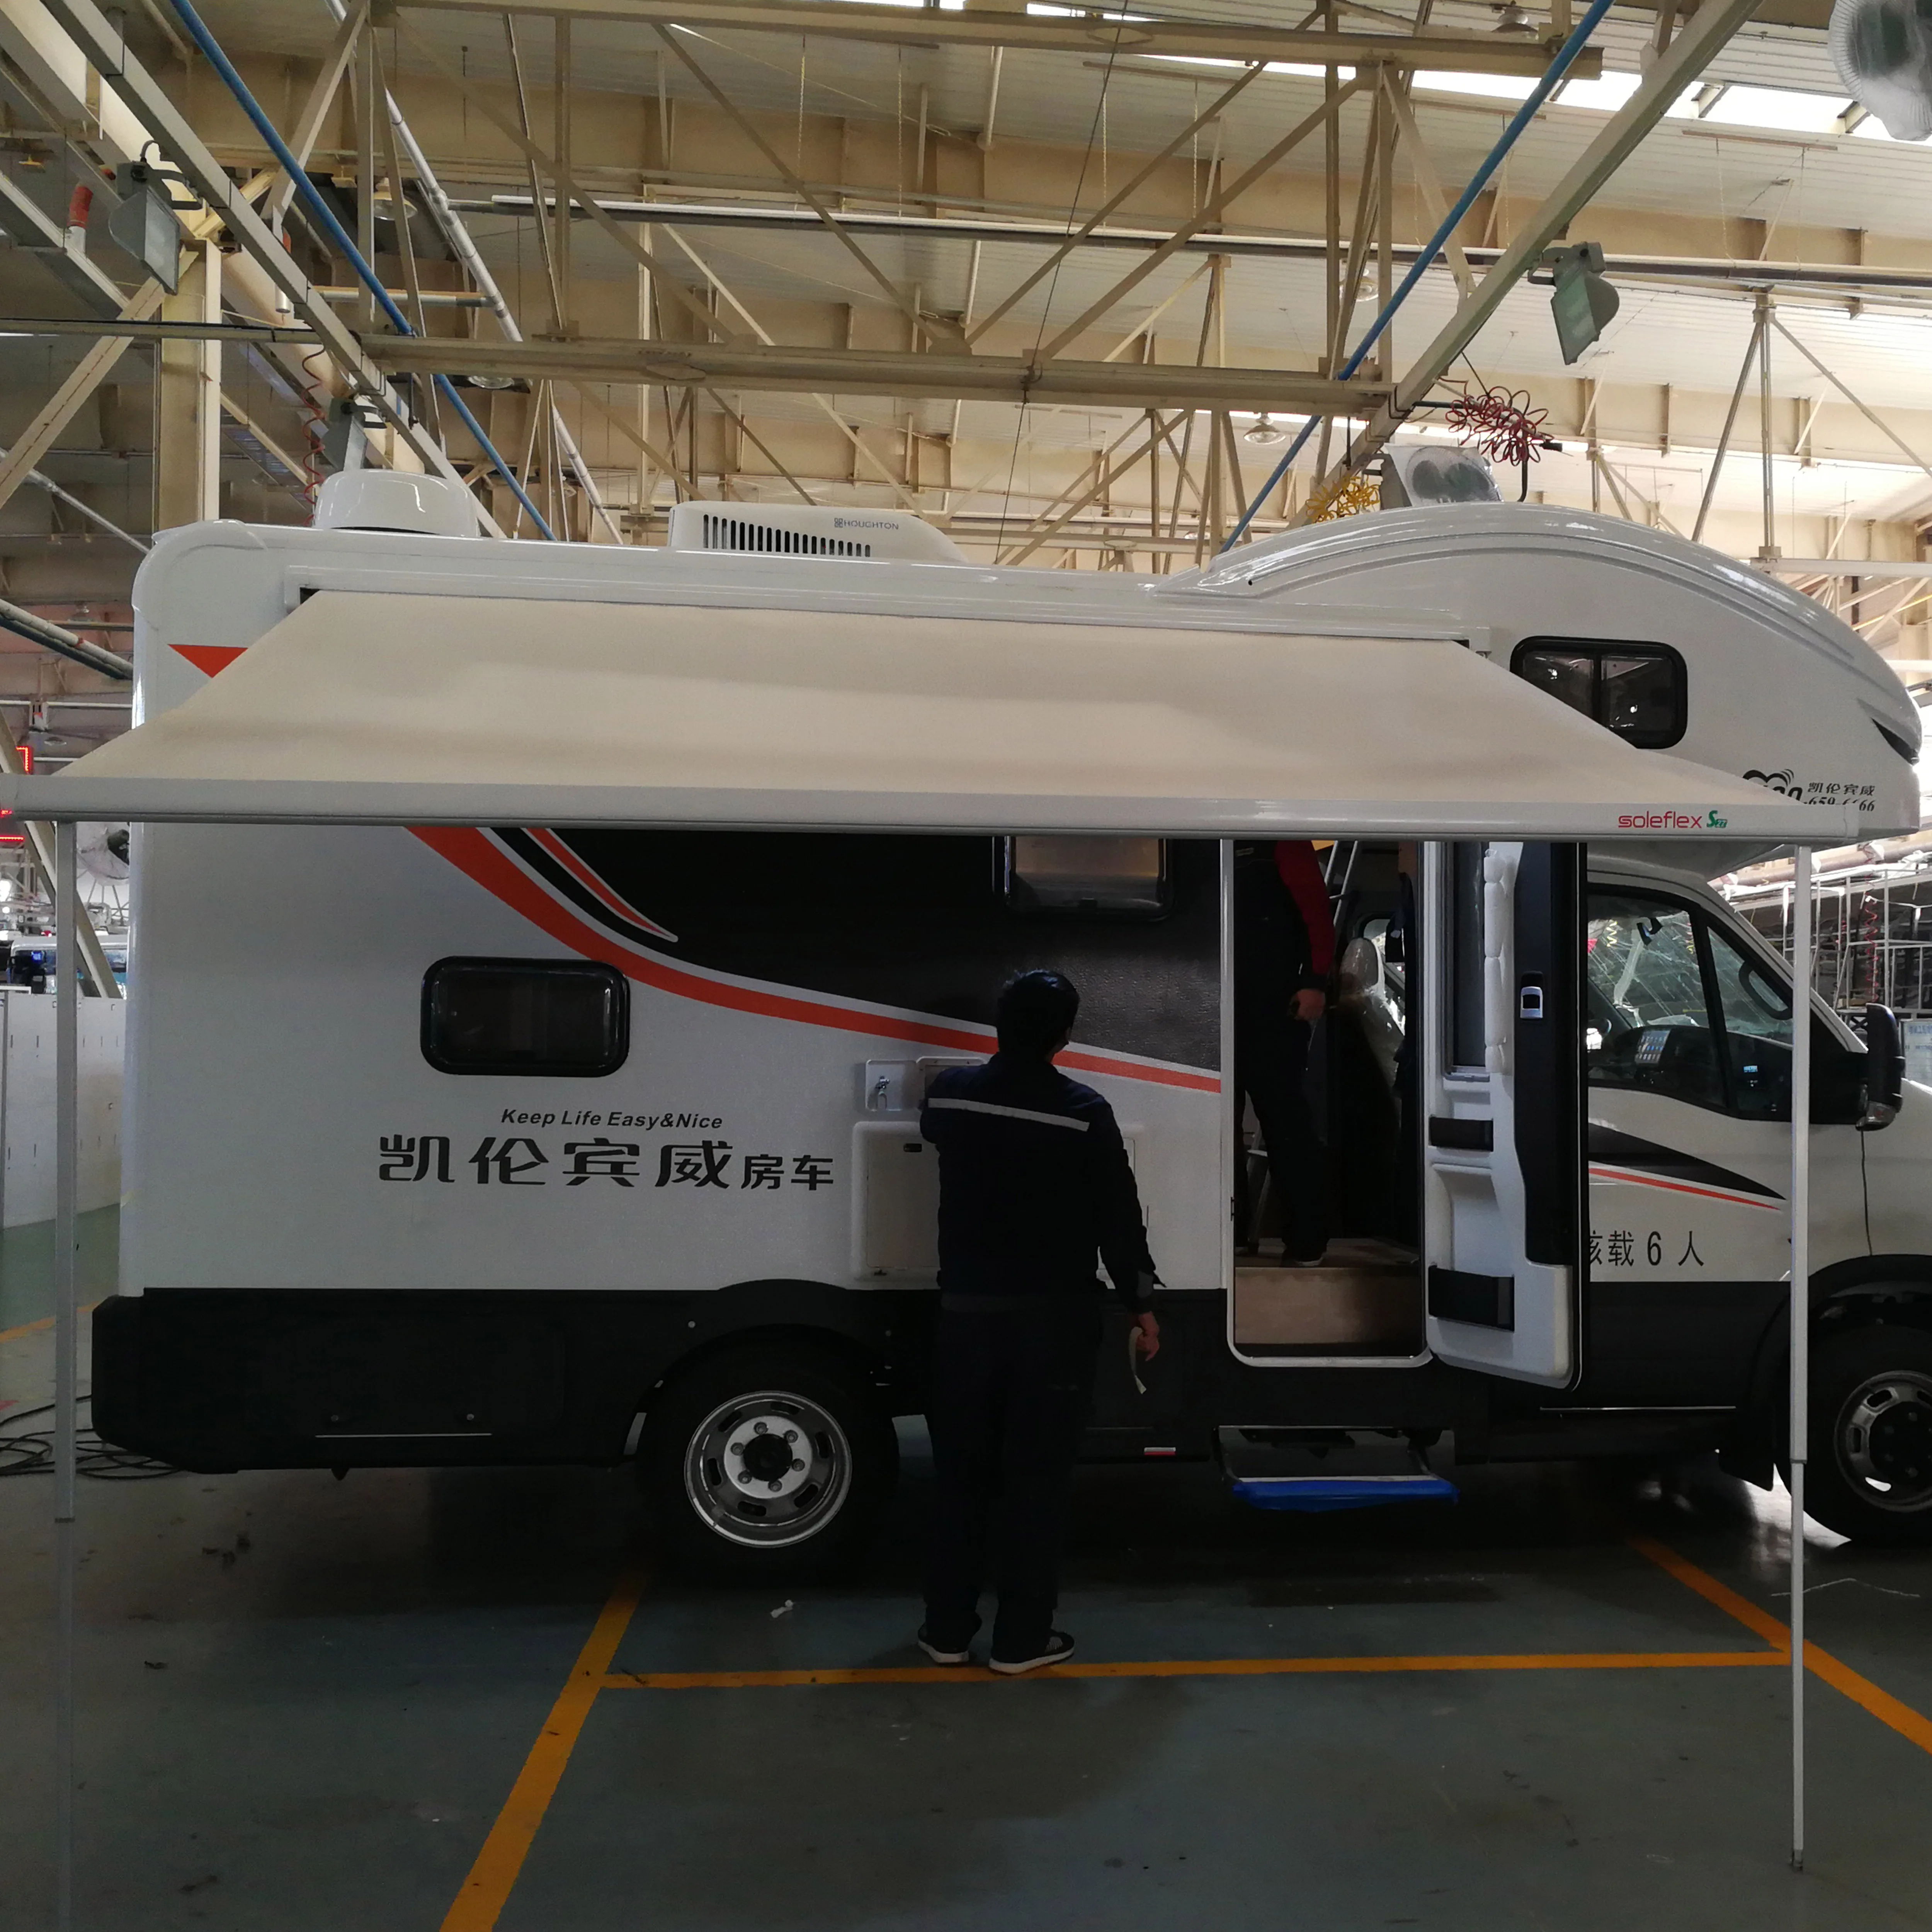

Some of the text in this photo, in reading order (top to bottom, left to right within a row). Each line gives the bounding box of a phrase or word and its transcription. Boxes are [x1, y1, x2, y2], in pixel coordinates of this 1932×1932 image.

[844, 520, 899, 530] HOUGHTON
[1807, 782, 1876, 796] 凯伦宾威
[1618, 811, 1702, 828] soleflex
[501, 1109, 722, 1131] Keep Life Easy&Nice
